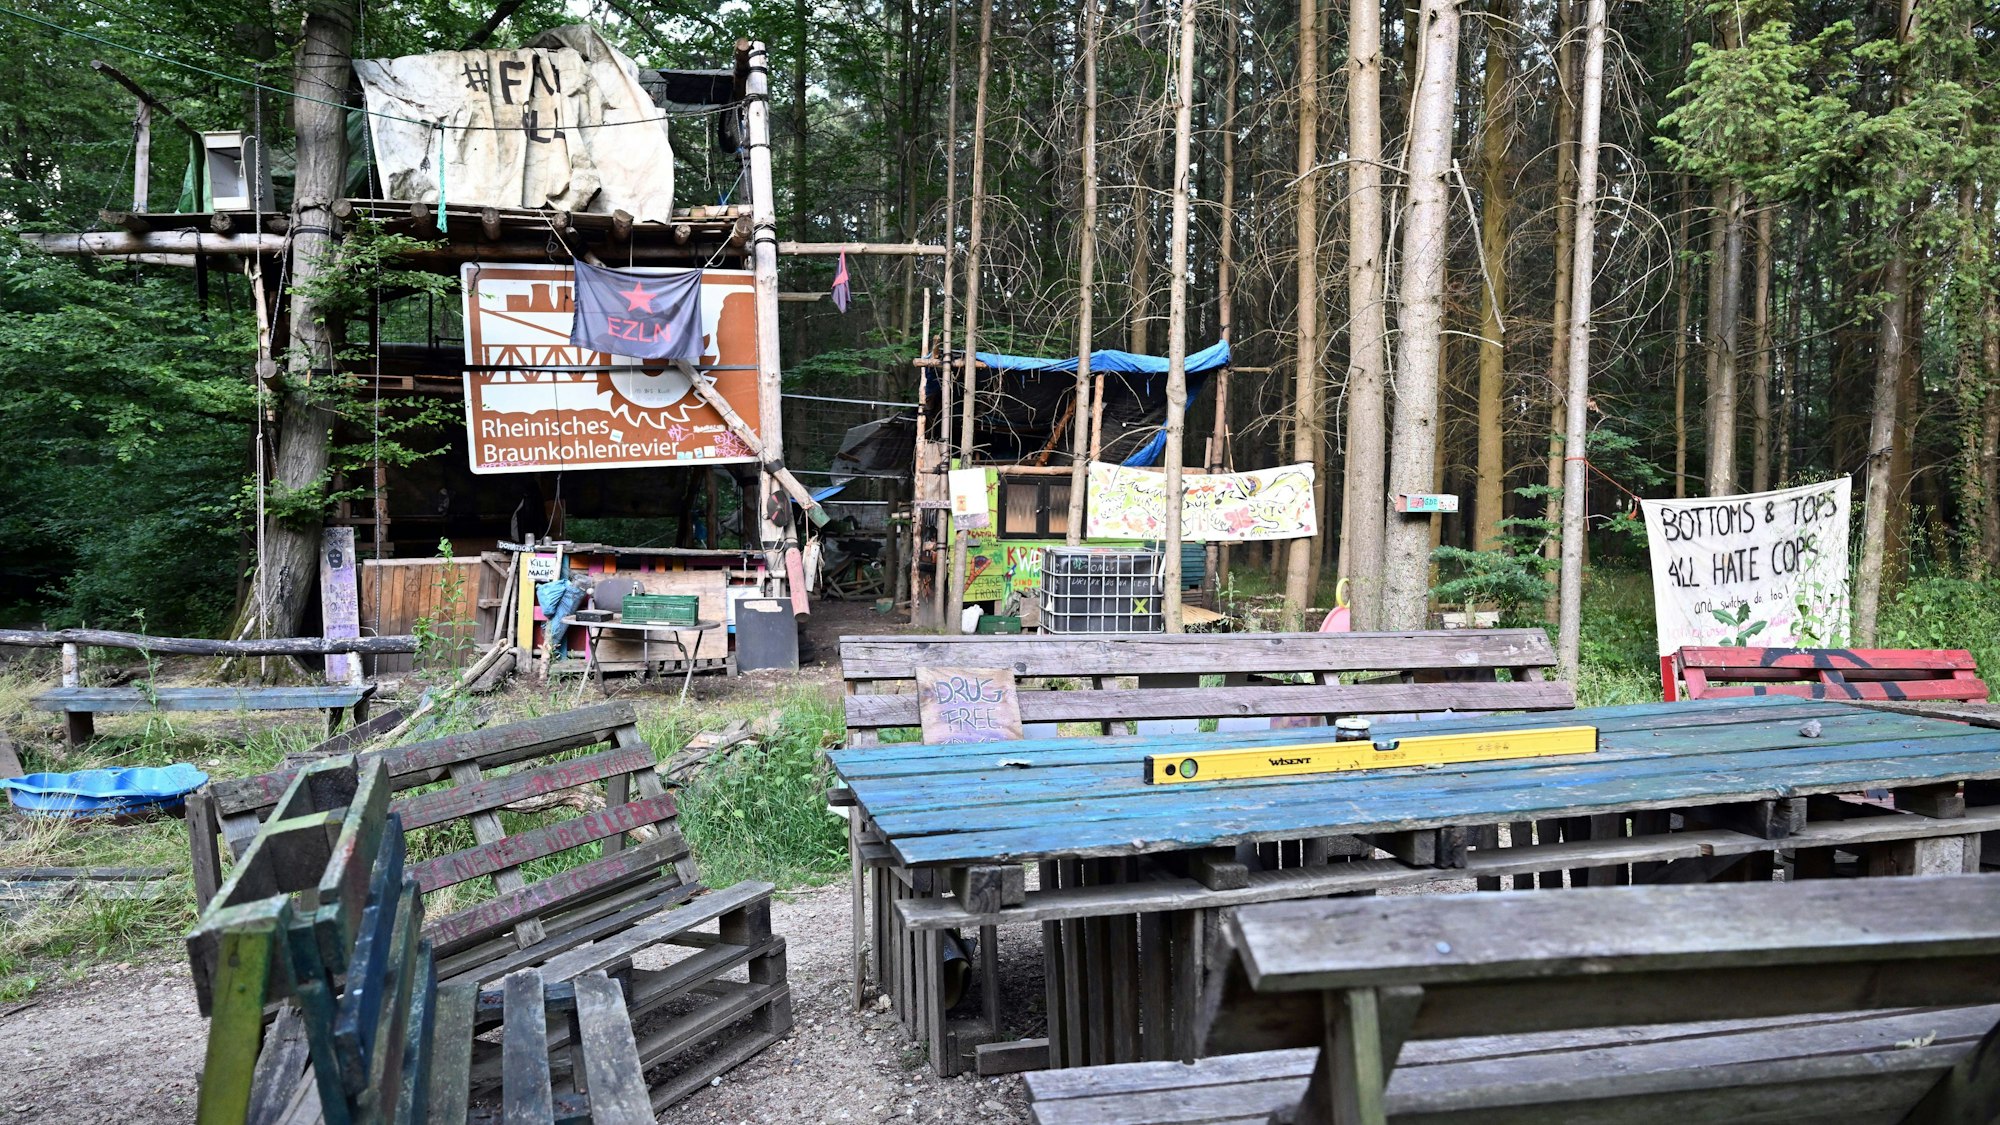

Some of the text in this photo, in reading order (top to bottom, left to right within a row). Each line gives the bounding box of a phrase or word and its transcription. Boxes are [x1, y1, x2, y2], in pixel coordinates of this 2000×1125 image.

[608, 317, 672, 343] EZLN
[481, 416, 610, 438] Rheinisches
[483, 438, 680, 463] Braunkohlenrevier
[1660, 490, 1838, 541] BOTTOMS & TOPS
[530, 558, 551, 567] KILL
[1668, 533, 1818, 588] ALL HATE COPS
[1694, 599, 1713, 615] and
[934, 676, 1003, 705] DRUG
[941, 707, 1003, 732] FREE
[1268, 756, 1311, 767] WISENT
